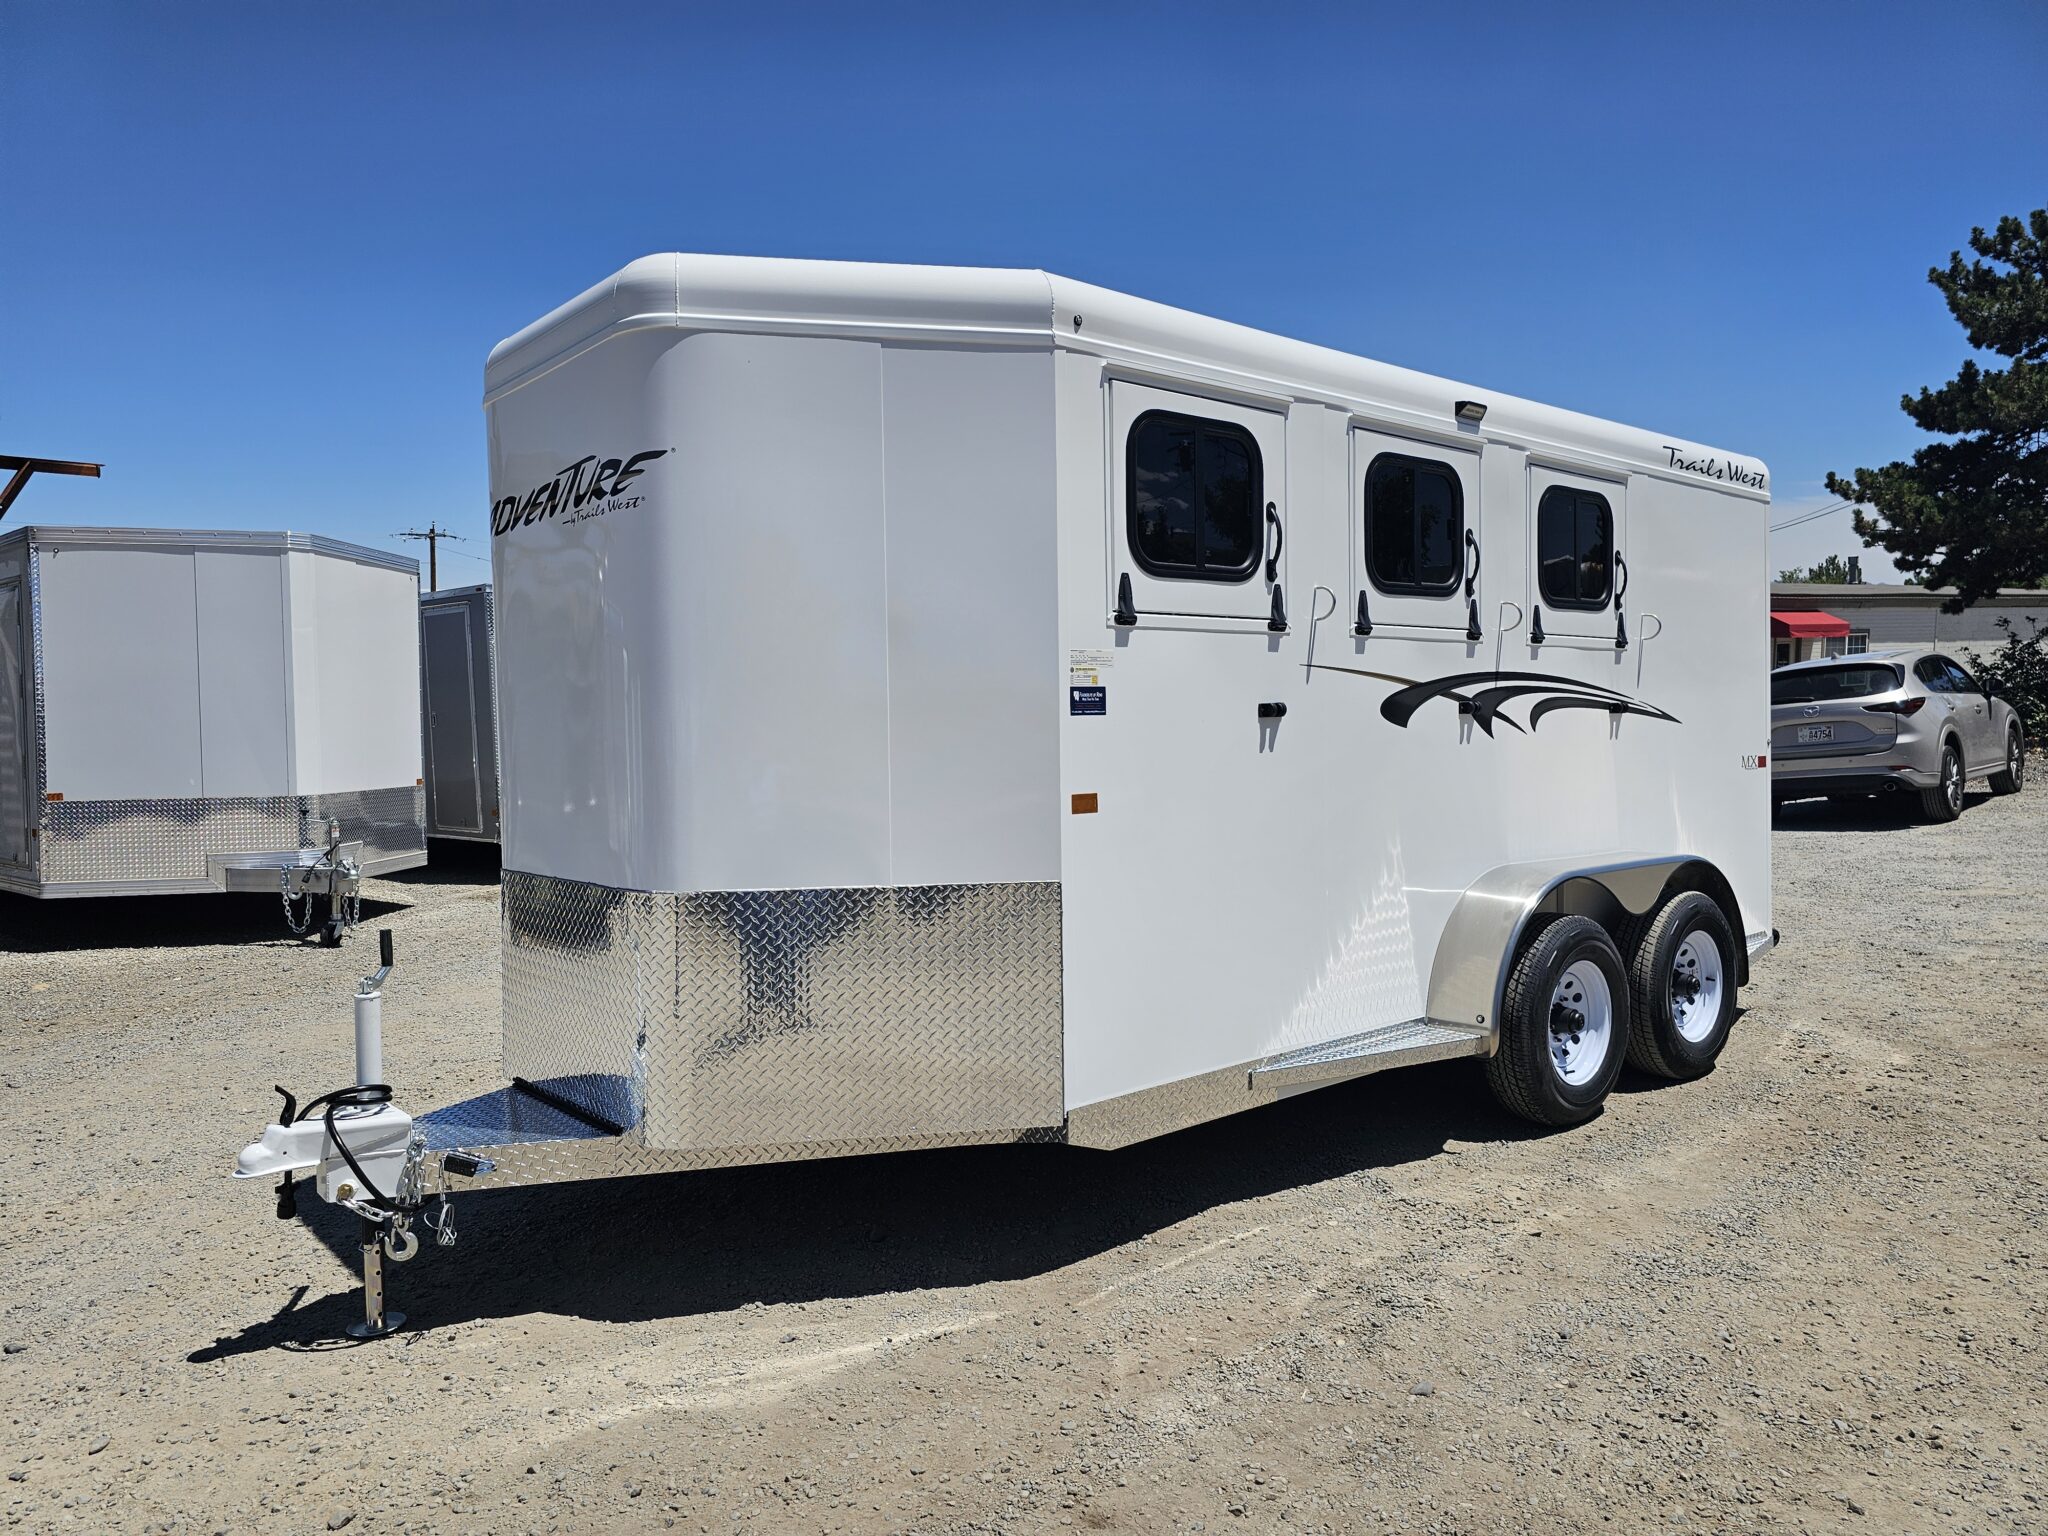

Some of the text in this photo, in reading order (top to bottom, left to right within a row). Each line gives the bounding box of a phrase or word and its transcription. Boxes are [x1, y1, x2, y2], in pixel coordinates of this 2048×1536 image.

[1663, 446, 1765, 489] Trails West
[574, 503, 605, 521] Trails
